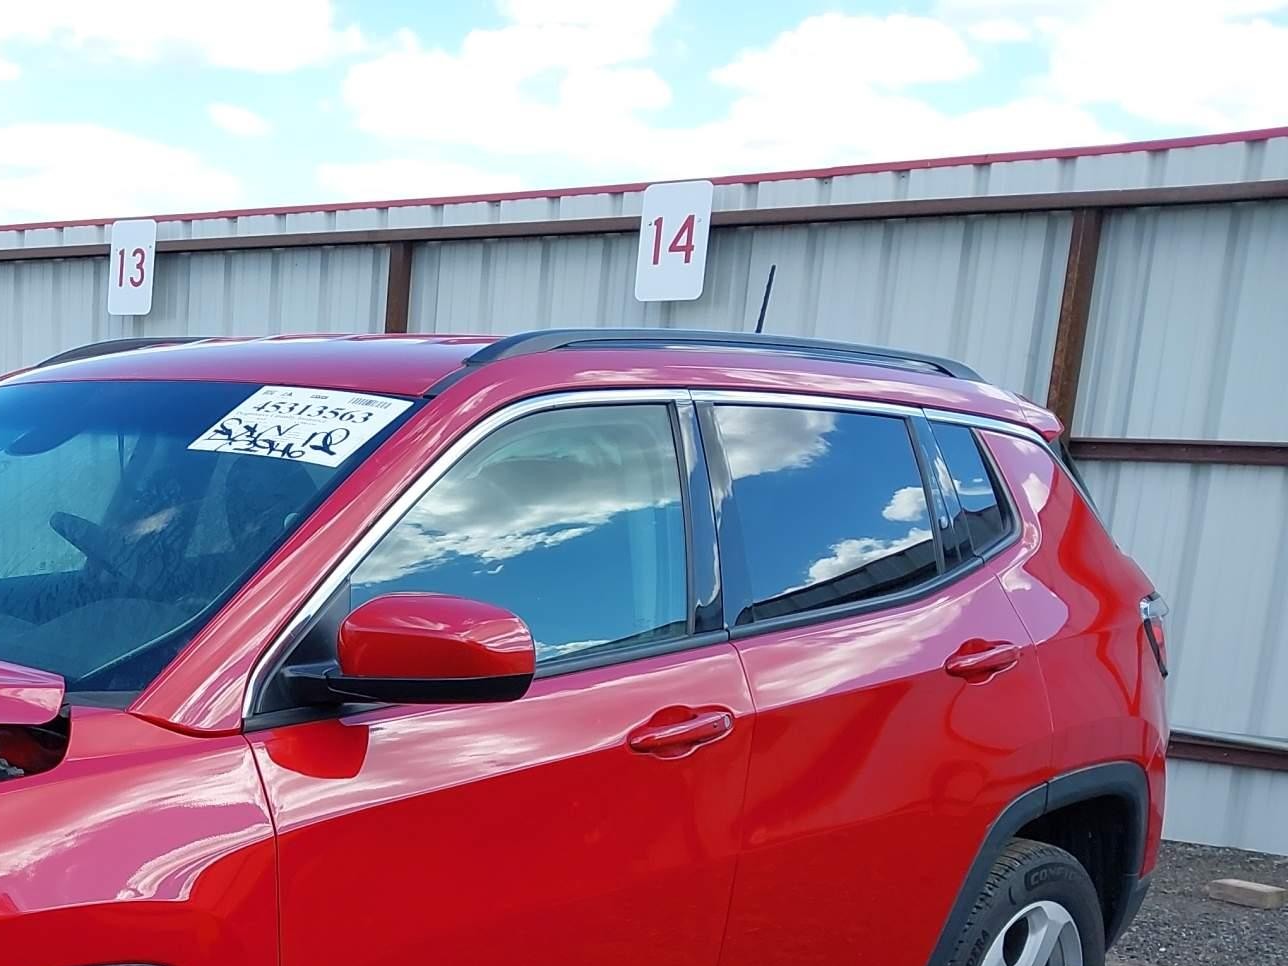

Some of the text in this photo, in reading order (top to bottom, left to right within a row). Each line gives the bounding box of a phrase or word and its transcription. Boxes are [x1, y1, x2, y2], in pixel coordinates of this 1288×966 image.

[649, 213, 697, 266] 14
[116, 247, 146, 289] 13
[253, 400, 374, 424] 45313563
